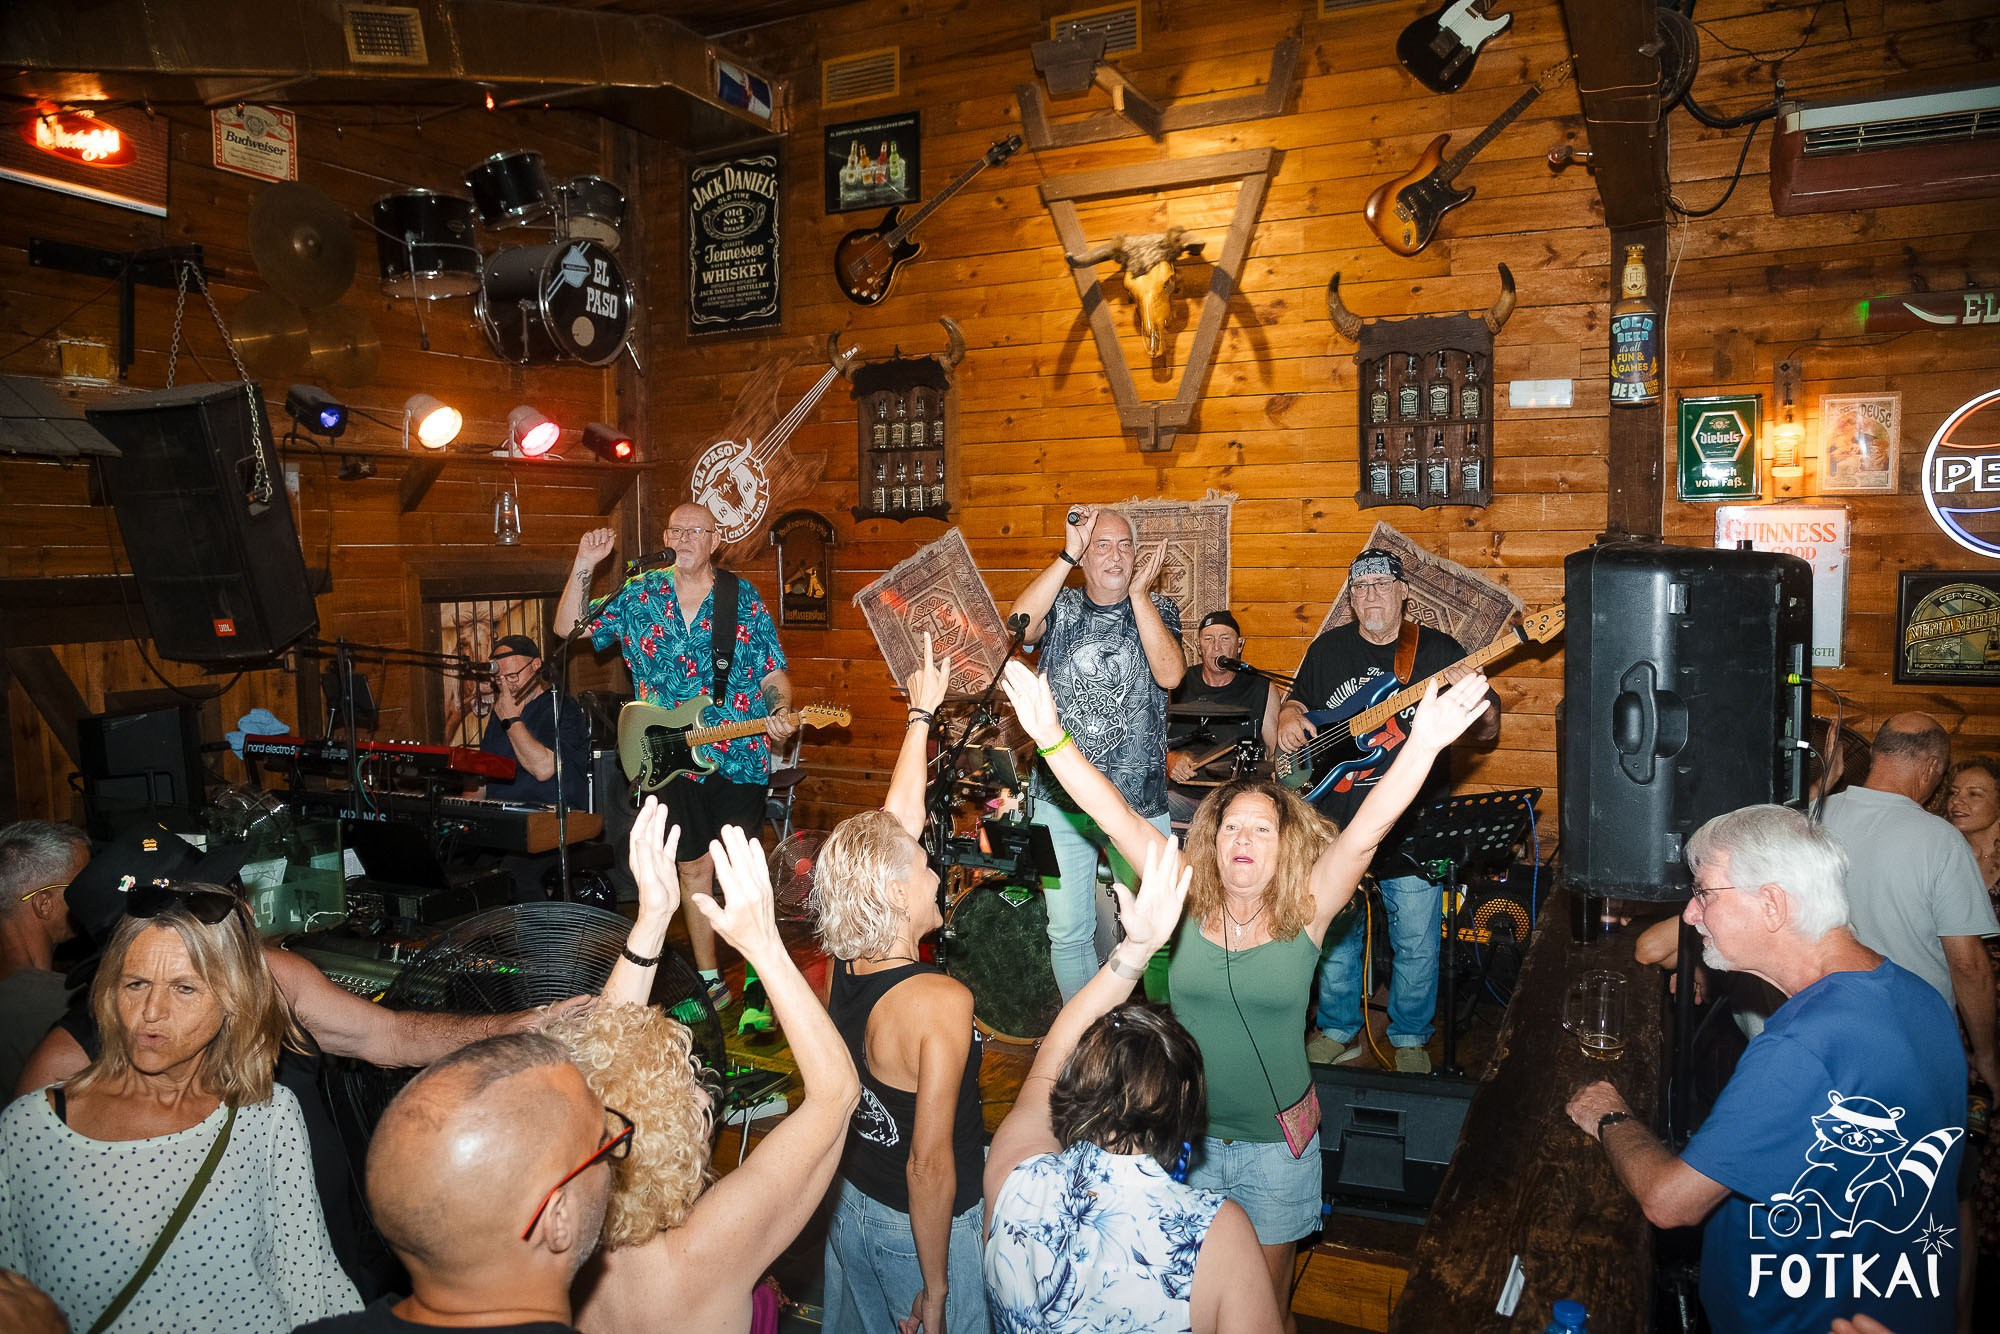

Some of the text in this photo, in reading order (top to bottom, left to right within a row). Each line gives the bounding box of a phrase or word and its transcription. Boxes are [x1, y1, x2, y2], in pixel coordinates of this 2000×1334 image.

[225, 130, 287, 156] Budweiser
[691, 176, 725, 211] JACK
[718, 194, 732, 204] OLD
[725, 208, 743, 218] Old
[704, 244, 765, 264] Tennessee
[593, 258, 610, 287] EL
[702, 263, 767, 285] WHISKEY
[585, 286, 618, 319] PASO
[1612, 317, 1653, 335] COLD
[1617, 330, 1649, 343] BEER
[1630, 341, 1641, 352] all
[1617, 351, 1645, 363] FUN &
[1618, 362, 1649, 373] GAMES
[1611, 382, 1647, 398] BEER
[694, 445, 733, 489] EL PASO
[1695, 480, 1719, 488] vom
[1724, 519, 1837, 543] GUINNESS
[1939, 592, 1986, 604] CERVEZA
[1366, 666, 1385, 677] The
[247, 743, 264, 754] nord
